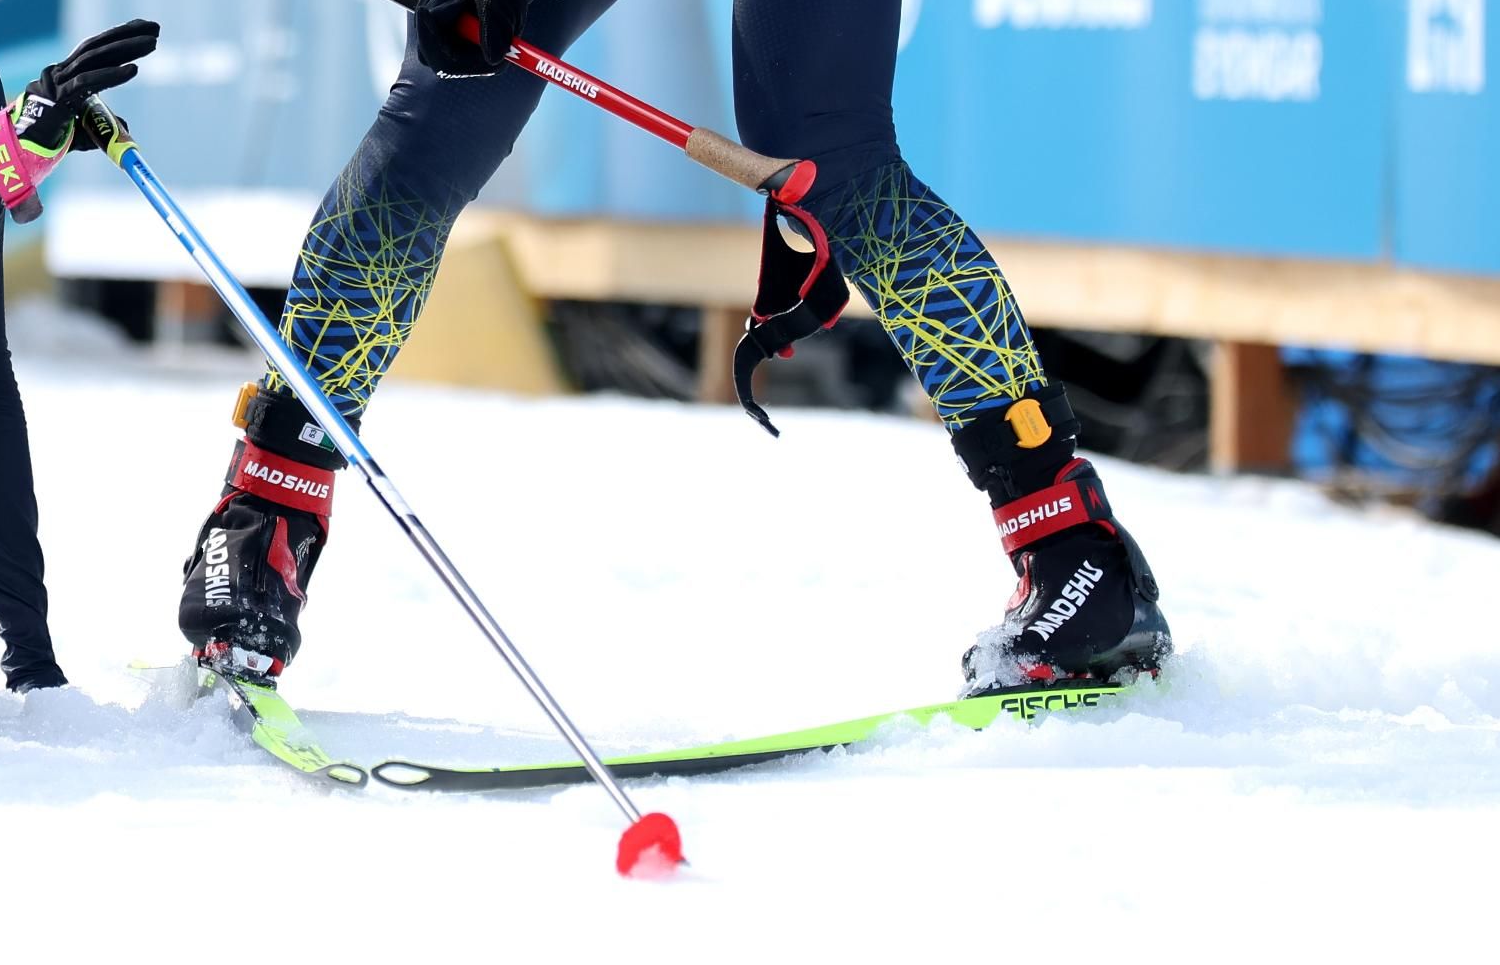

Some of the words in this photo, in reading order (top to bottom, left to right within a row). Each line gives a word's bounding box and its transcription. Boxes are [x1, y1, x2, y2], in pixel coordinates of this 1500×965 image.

[535, 59, 600, 99] MADSHUS
[92, 110, 112, 136] LEKI
[243, 460, 330, 499] MADSHUS
[1027, 559, 1105, 643] MADSHU
[1000, 691, 1117, 720] FISCHE
